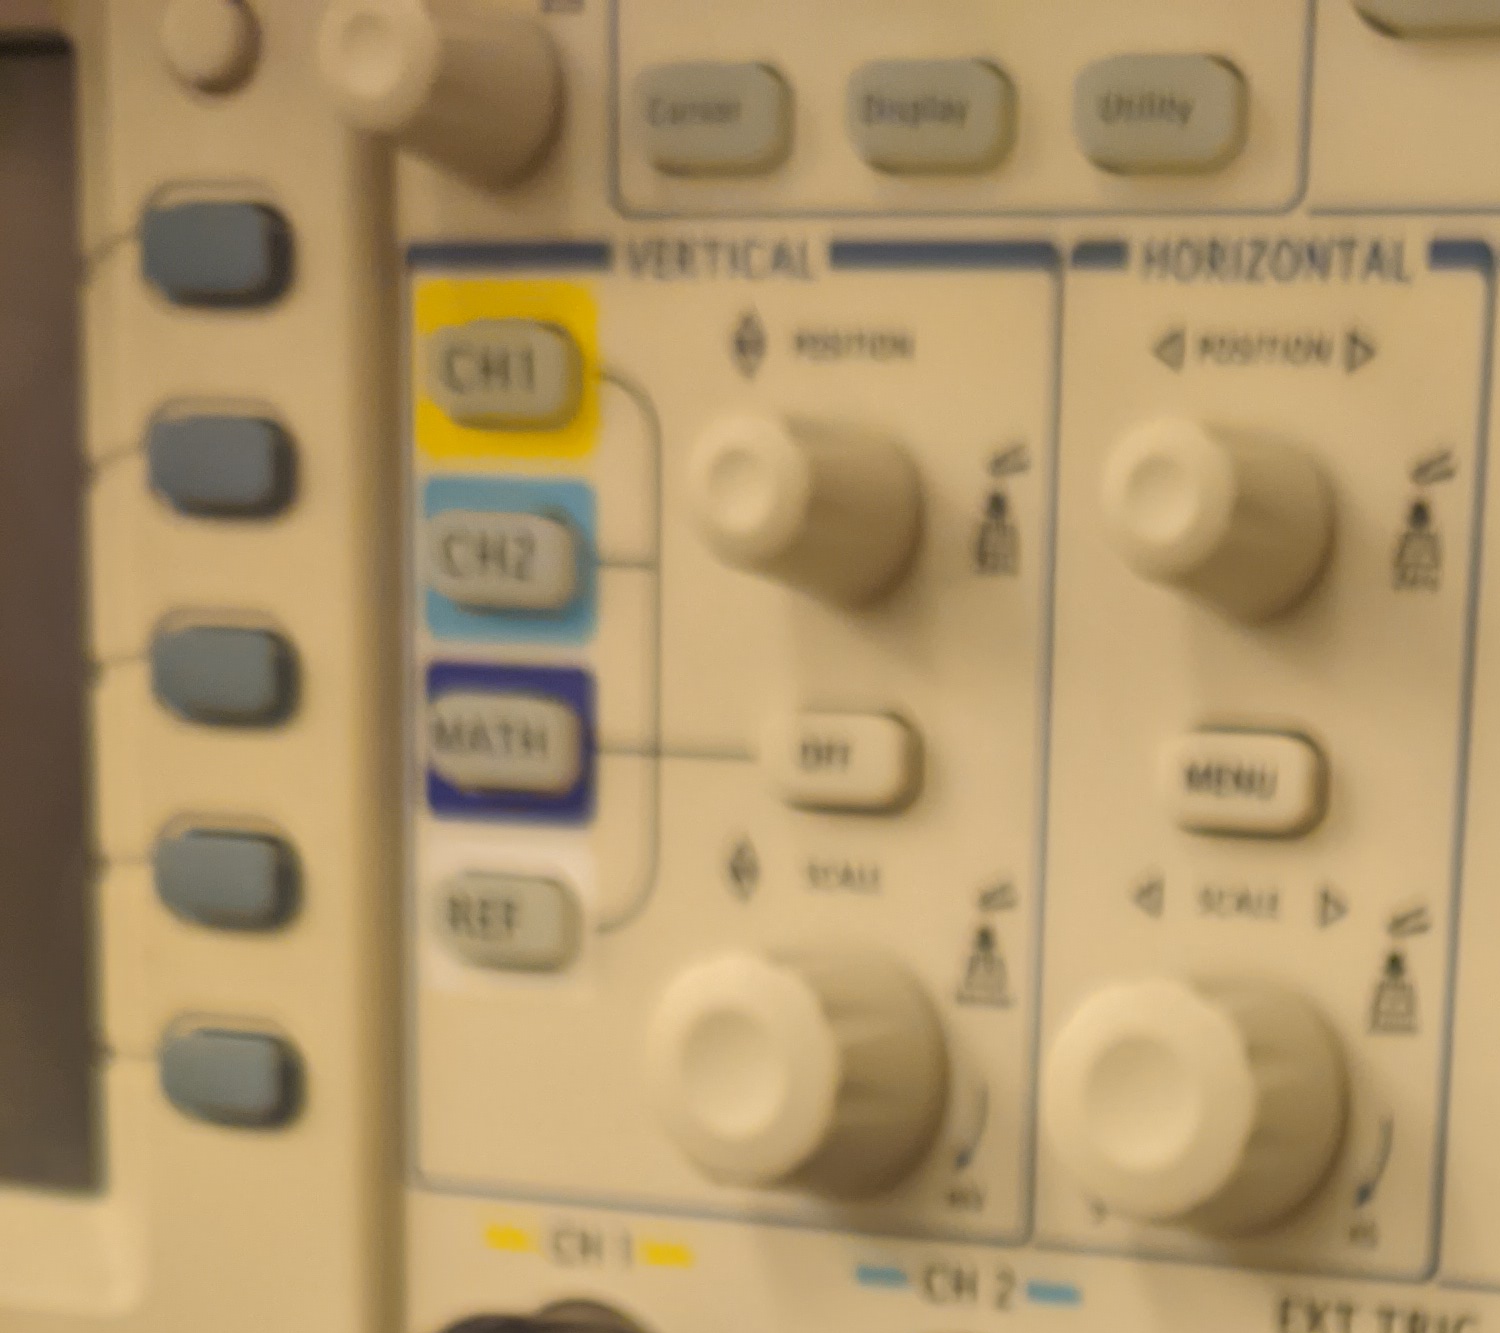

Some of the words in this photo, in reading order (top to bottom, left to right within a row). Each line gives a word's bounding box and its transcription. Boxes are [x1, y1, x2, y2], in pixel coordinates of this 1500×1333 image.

[624, 237, 817, 281] VERTICAL
[1143, 236, 1412, 285] HORIZONTAL
[441, 344, 537, 395] CH1
[1196, 334, 1335, 367] POSITION
[441, 528, 537, 566] CH2
[432, 716, 550, 757] MATH
[1182, 762, 1277, 799] MENU
